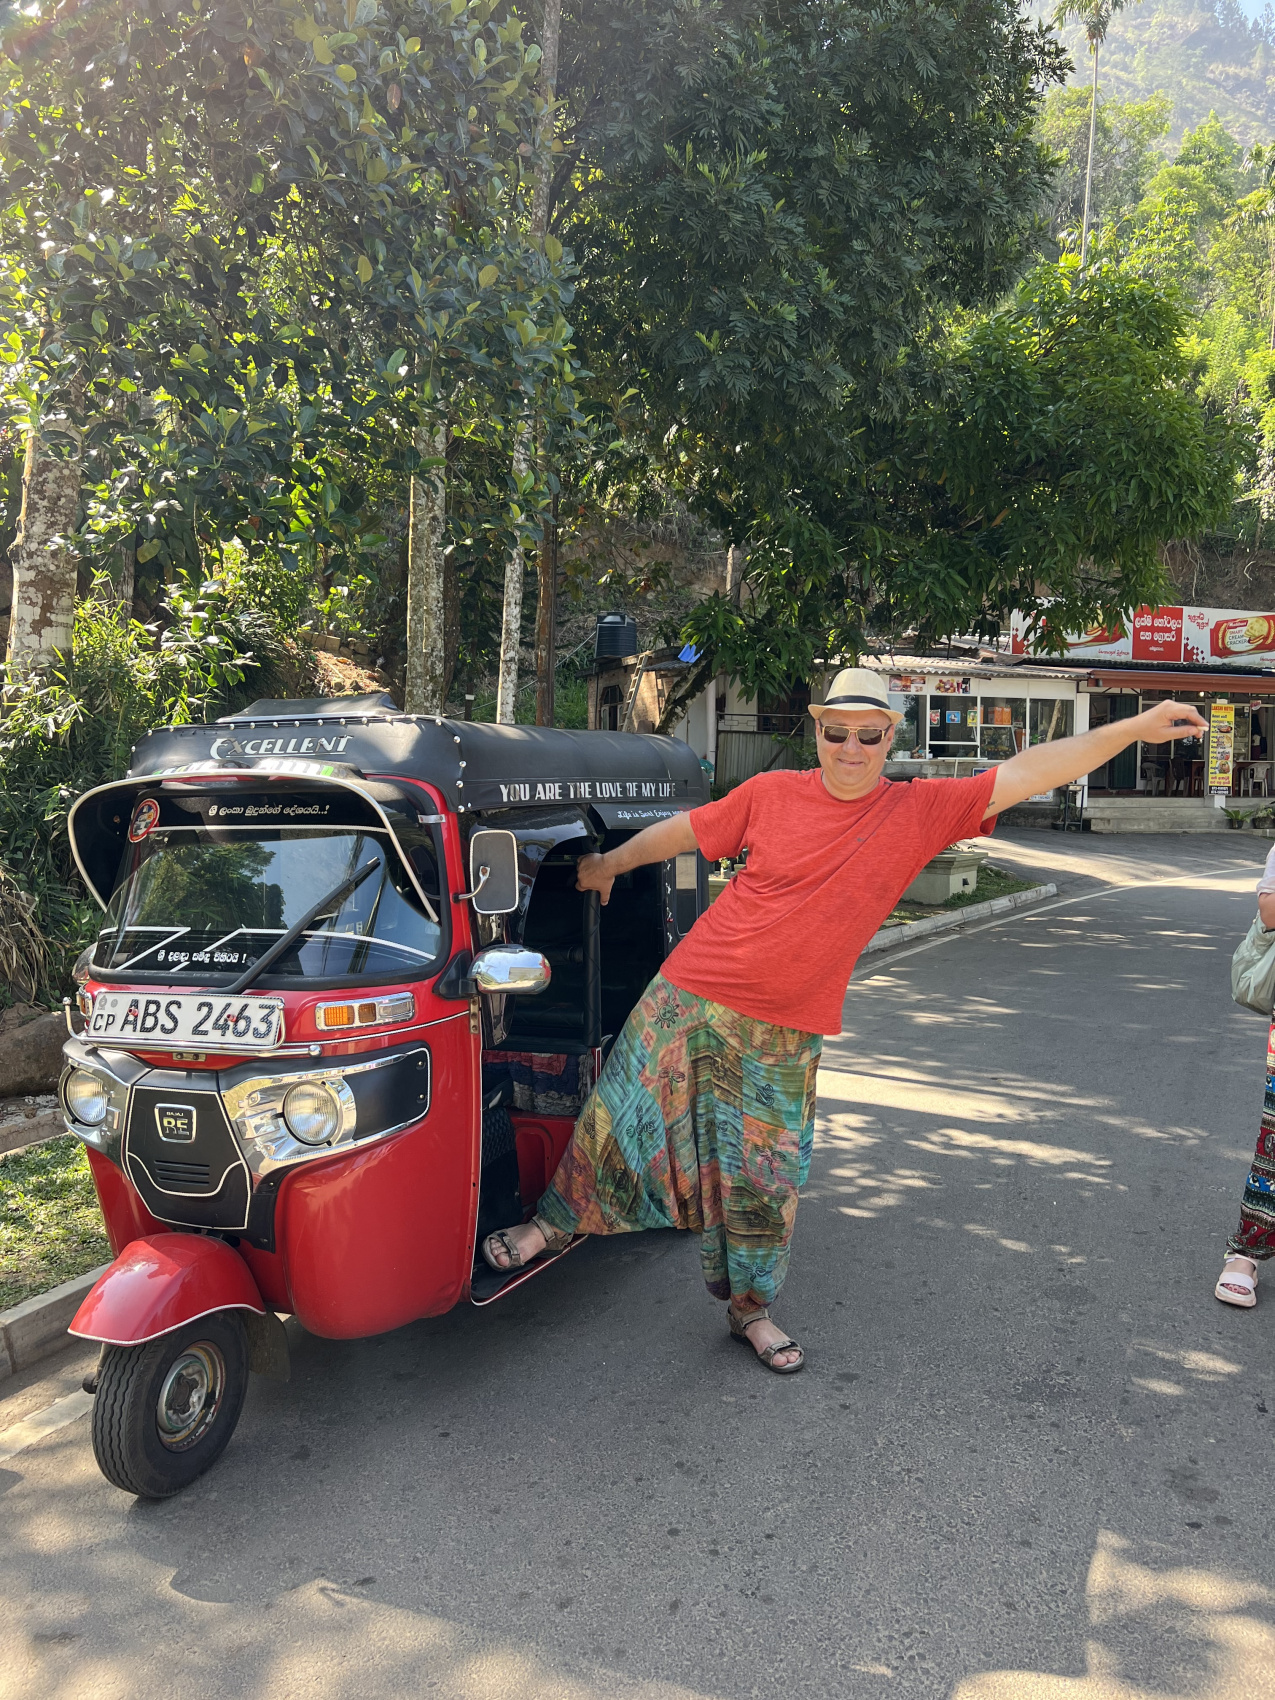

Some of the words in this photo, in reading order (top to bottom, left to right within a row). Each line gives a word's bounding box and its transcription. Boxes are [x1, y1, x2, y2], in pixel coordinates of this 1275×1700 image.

[210, 735, 354, 759] EXCELLENT
[499, 784, 530, 802] YOU
[535, 783, 562, 801] ARE
[567, 782, 593, 799] THE
[596, 782, 623, 799] LOVE
[626, 783, 638, 798] OF
[642, 783, 655, 798] MY
[659, 783, 676, 798] LIFE
[219, 806, 243, 816] ලංකා
[92, 1013, 116, 1032] CP
[120, 998, 182, 1034] ABS
[191, 1001, 276, 1038] 2463
[163, 1117, 190, 1136] RE
